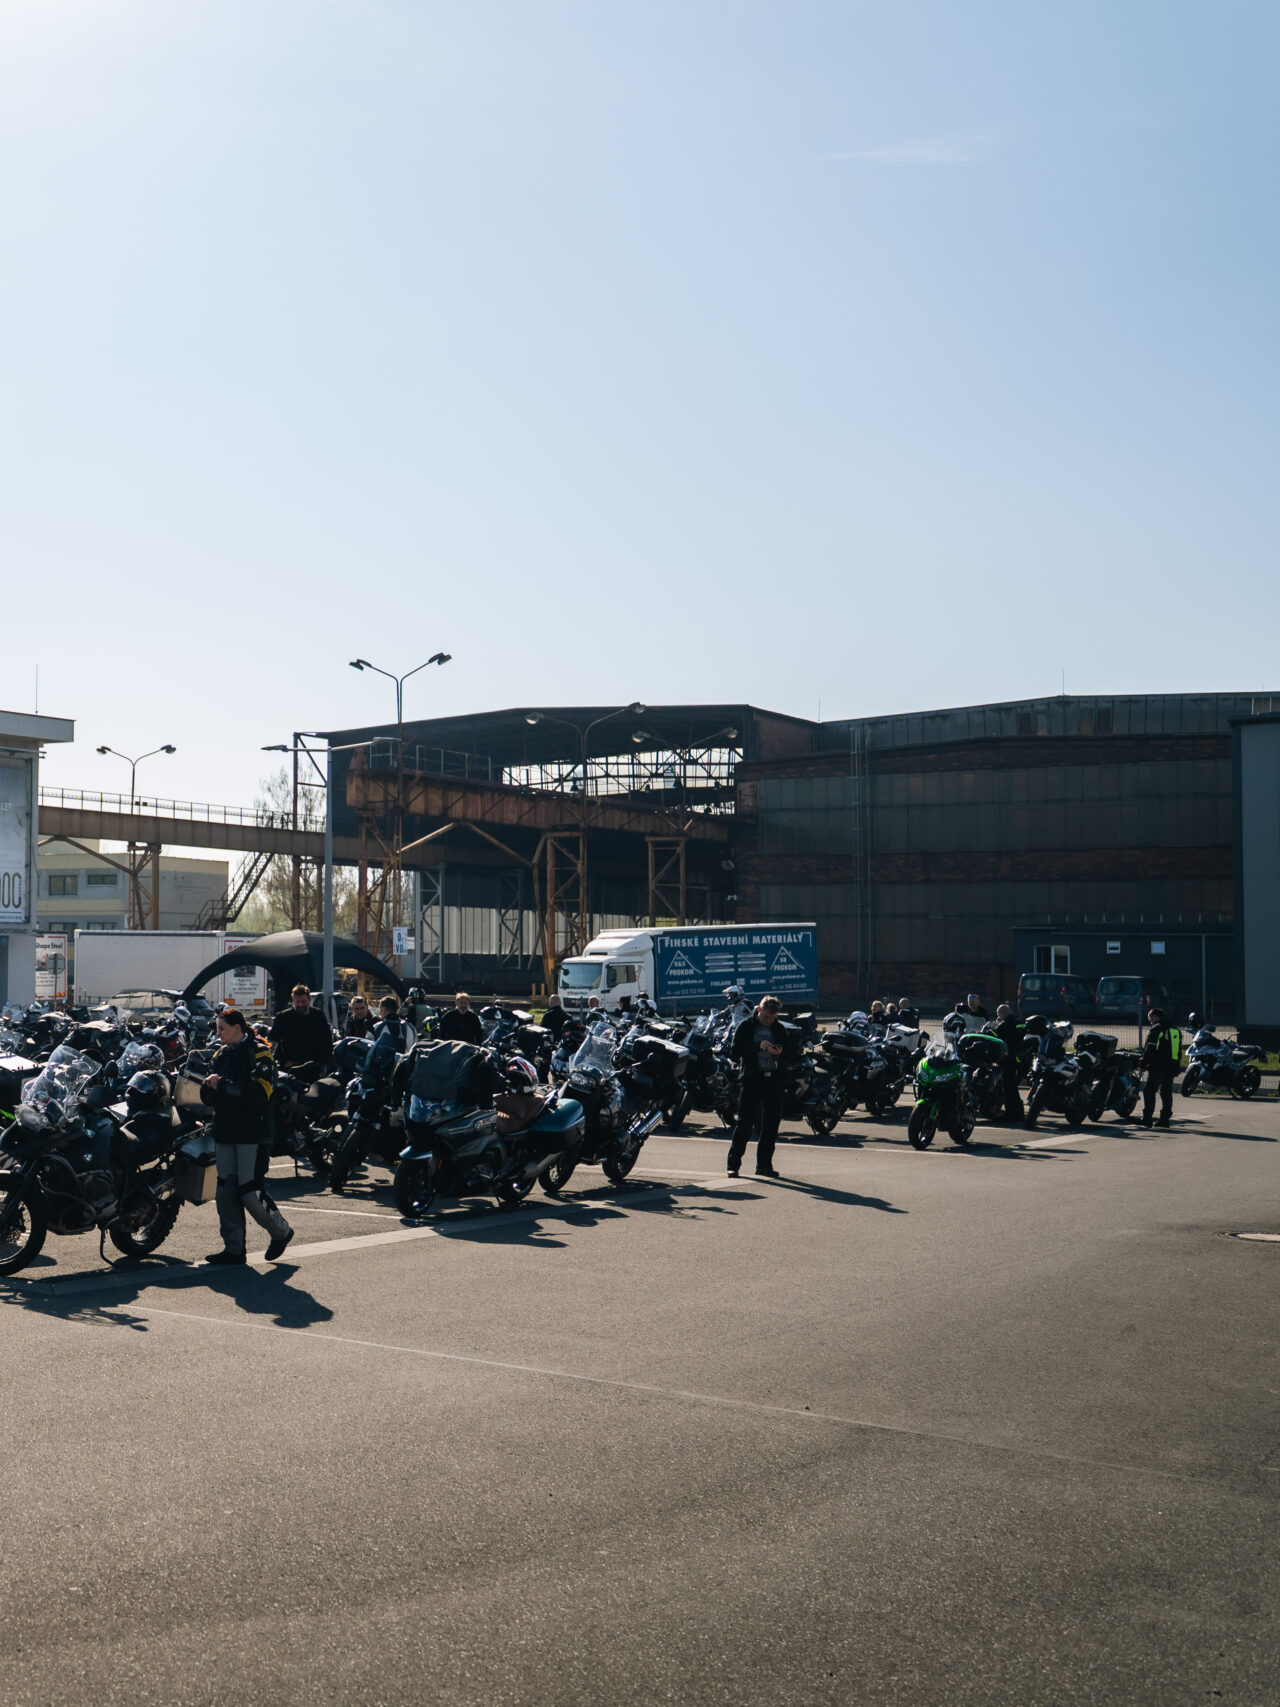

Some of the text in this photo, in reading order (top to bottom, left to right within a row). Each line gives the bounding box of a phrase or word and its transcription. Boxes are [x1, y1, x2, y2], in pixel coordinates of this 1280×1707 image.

[1, 802, 12, 811] LET
[664, 932, 803, 948] FINSKÉ STAVEBNÍ MATERIÁLY
